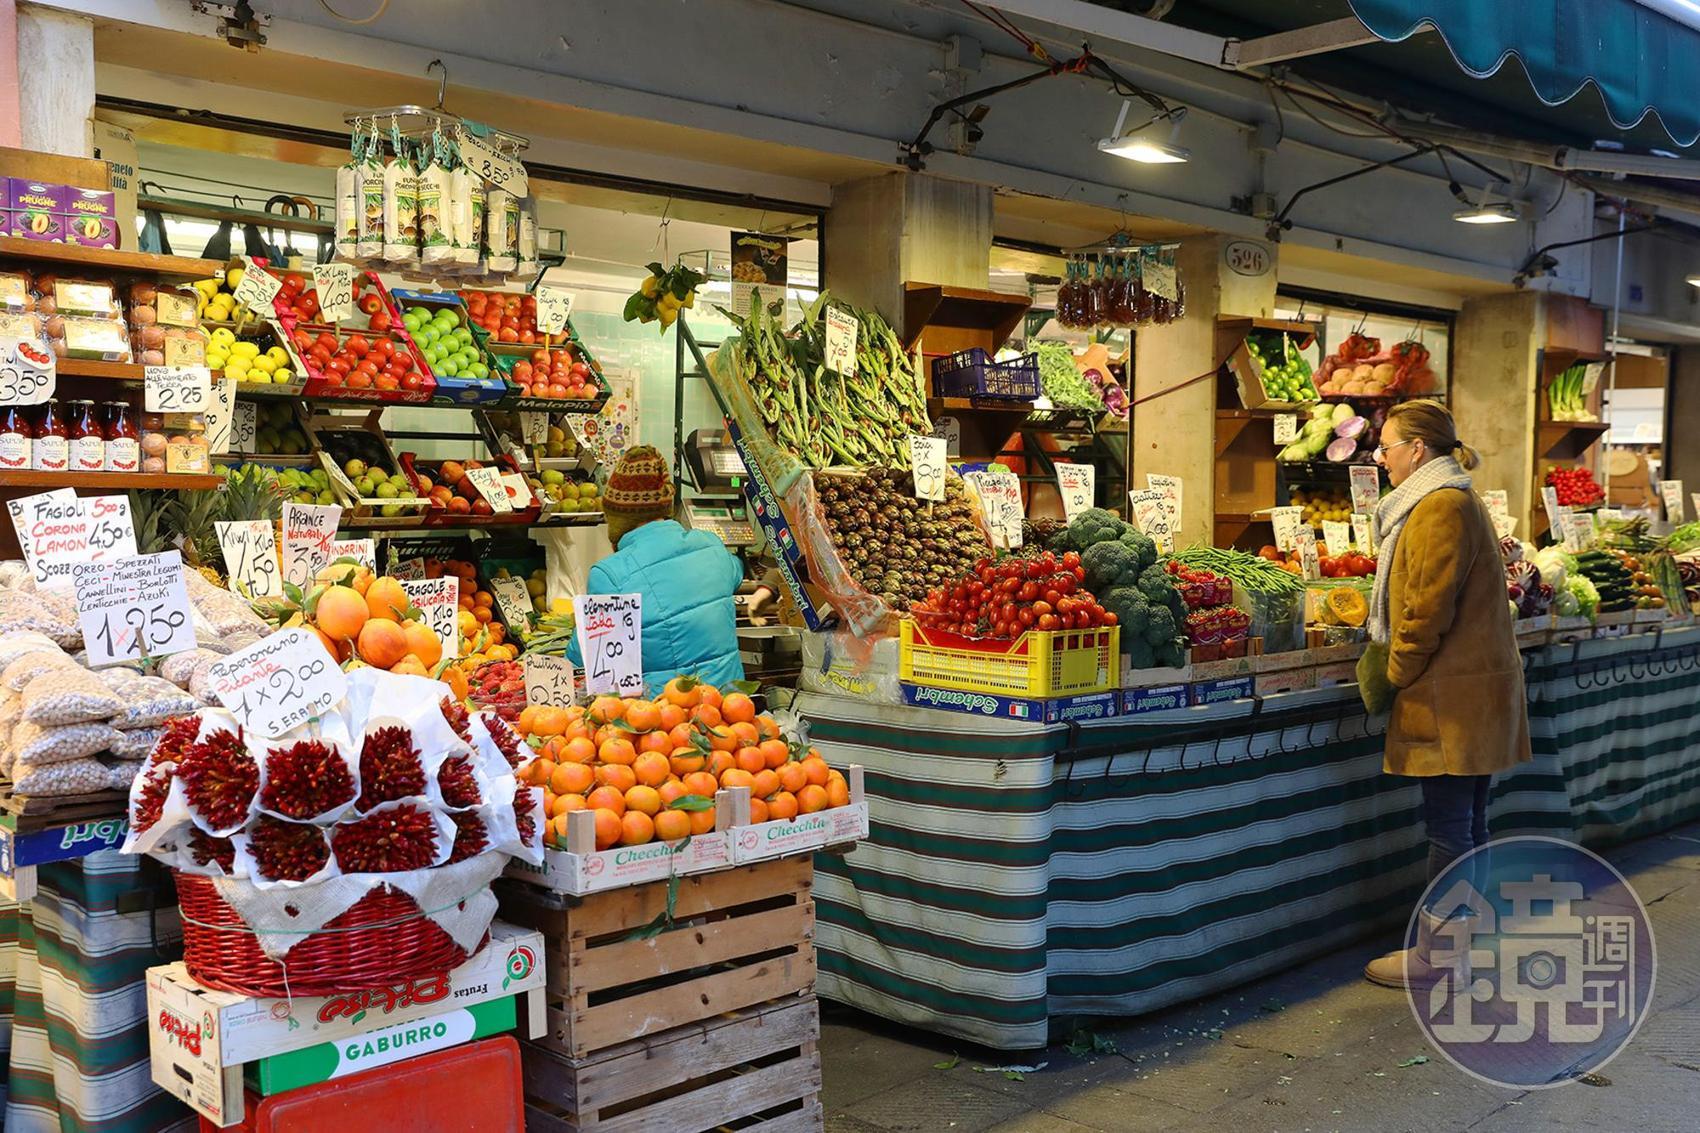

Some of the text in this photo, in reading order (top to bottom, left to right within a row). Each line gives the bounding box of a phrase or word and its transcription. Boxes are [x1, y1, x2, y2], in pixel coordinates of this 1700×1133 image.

[517, 399, 593, 409] MelaPiù
[31, 522, 87, 538] CORONA
[34, 537, 87, 556] LAMON
[72, 555, 161, 577] ORZO SPEZZATI
[74, 576, 102, 588] CECI
[153, 564, 182, 576] LEGUMI
[915, 687, 999, 714] Schembri
[1136, 695, 1176, 710] Schembri
[1060, 703, 1103, 719] Schembri
[454, 983, 489, 999] Frutas
[345, 1022, 448, 1061] GABURRO
